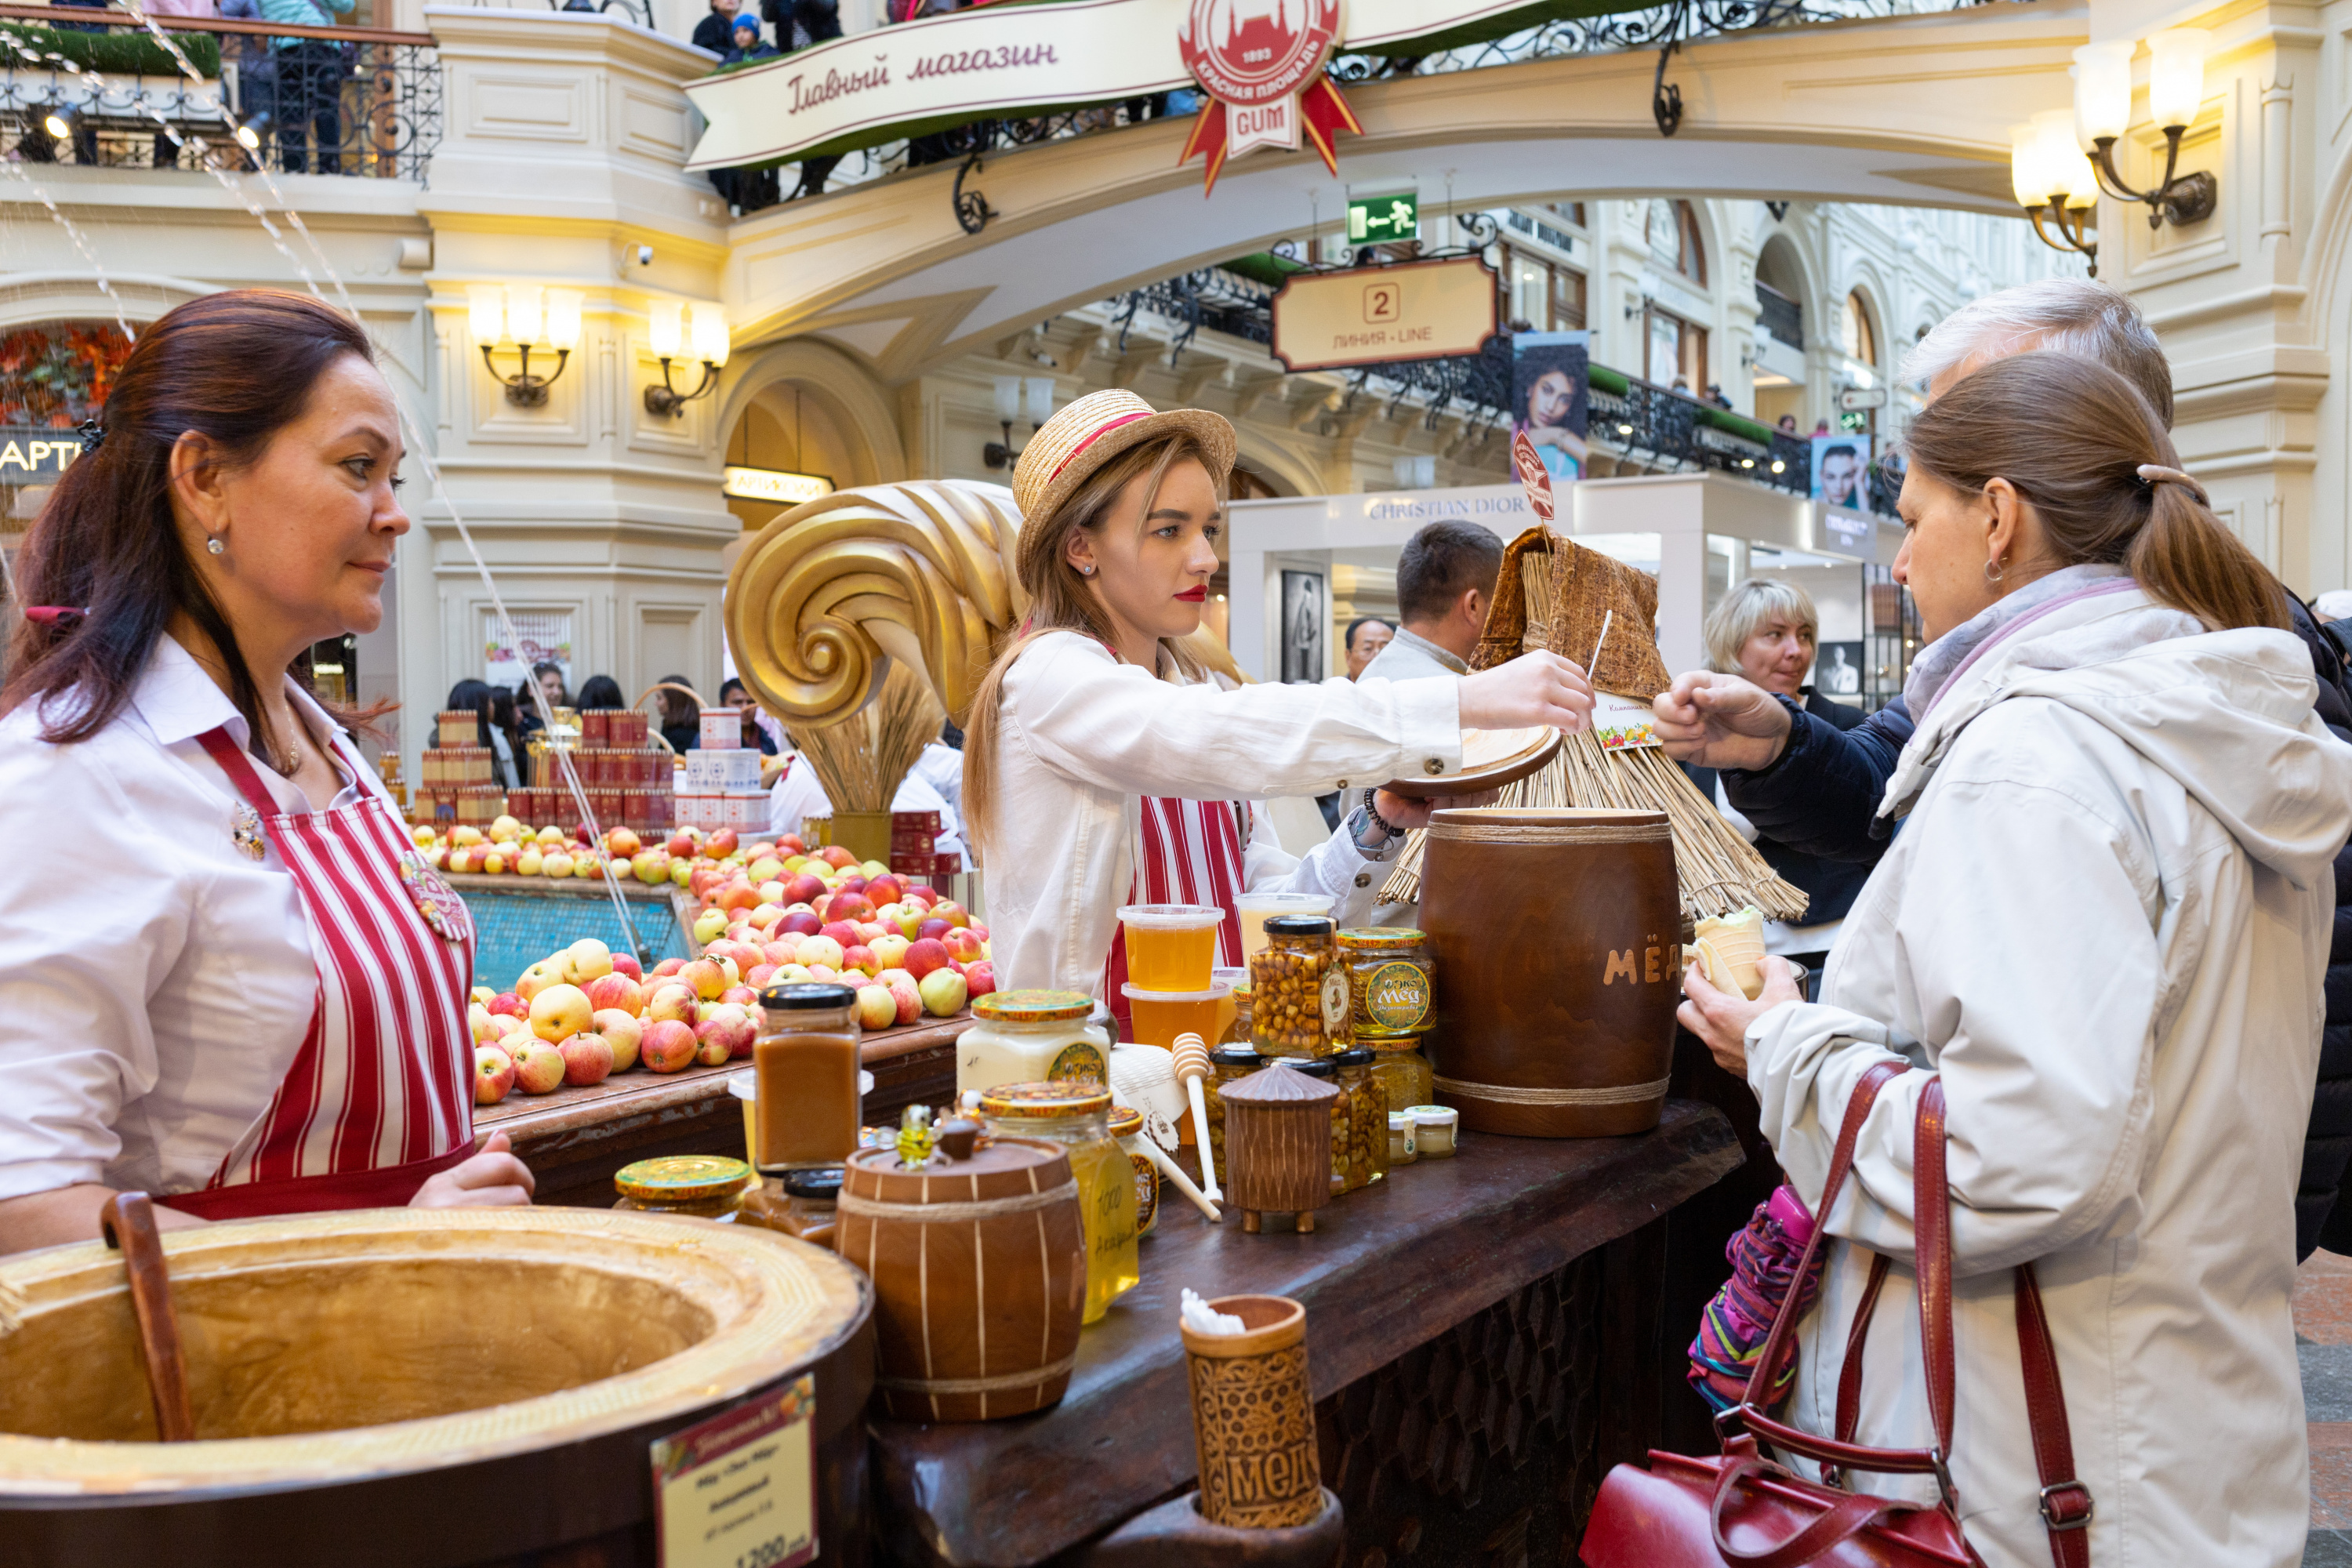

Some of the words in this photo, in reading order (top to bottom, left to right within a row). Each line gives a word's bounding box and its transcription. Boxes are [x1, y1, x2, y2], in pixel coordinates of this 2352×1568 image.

[788, 54, 890, 114] Главный
[906, 42, 1058, 80] магазин
[1196, 60, 1254, 99] КРАСНАЯ
[1255, 41, 1320, 99] ПЛОЩАДЬ
[1236, 104, 1284, 136] GUM
[1374, 291, 1389, 316] 2
[1333, 330, 1386, 350] ЛИНИЯ
[1398, 325, 1432, 343] LINE
[1370, 499, 1472, 521] CHRISTIAN
[1475, 496, 1525, 514] DIOR
[1609, 703, 1644, 713] Компания
[1602, 933, 1679, 986] МЁД
[1377, 987, 1421, 1004] Мёд
